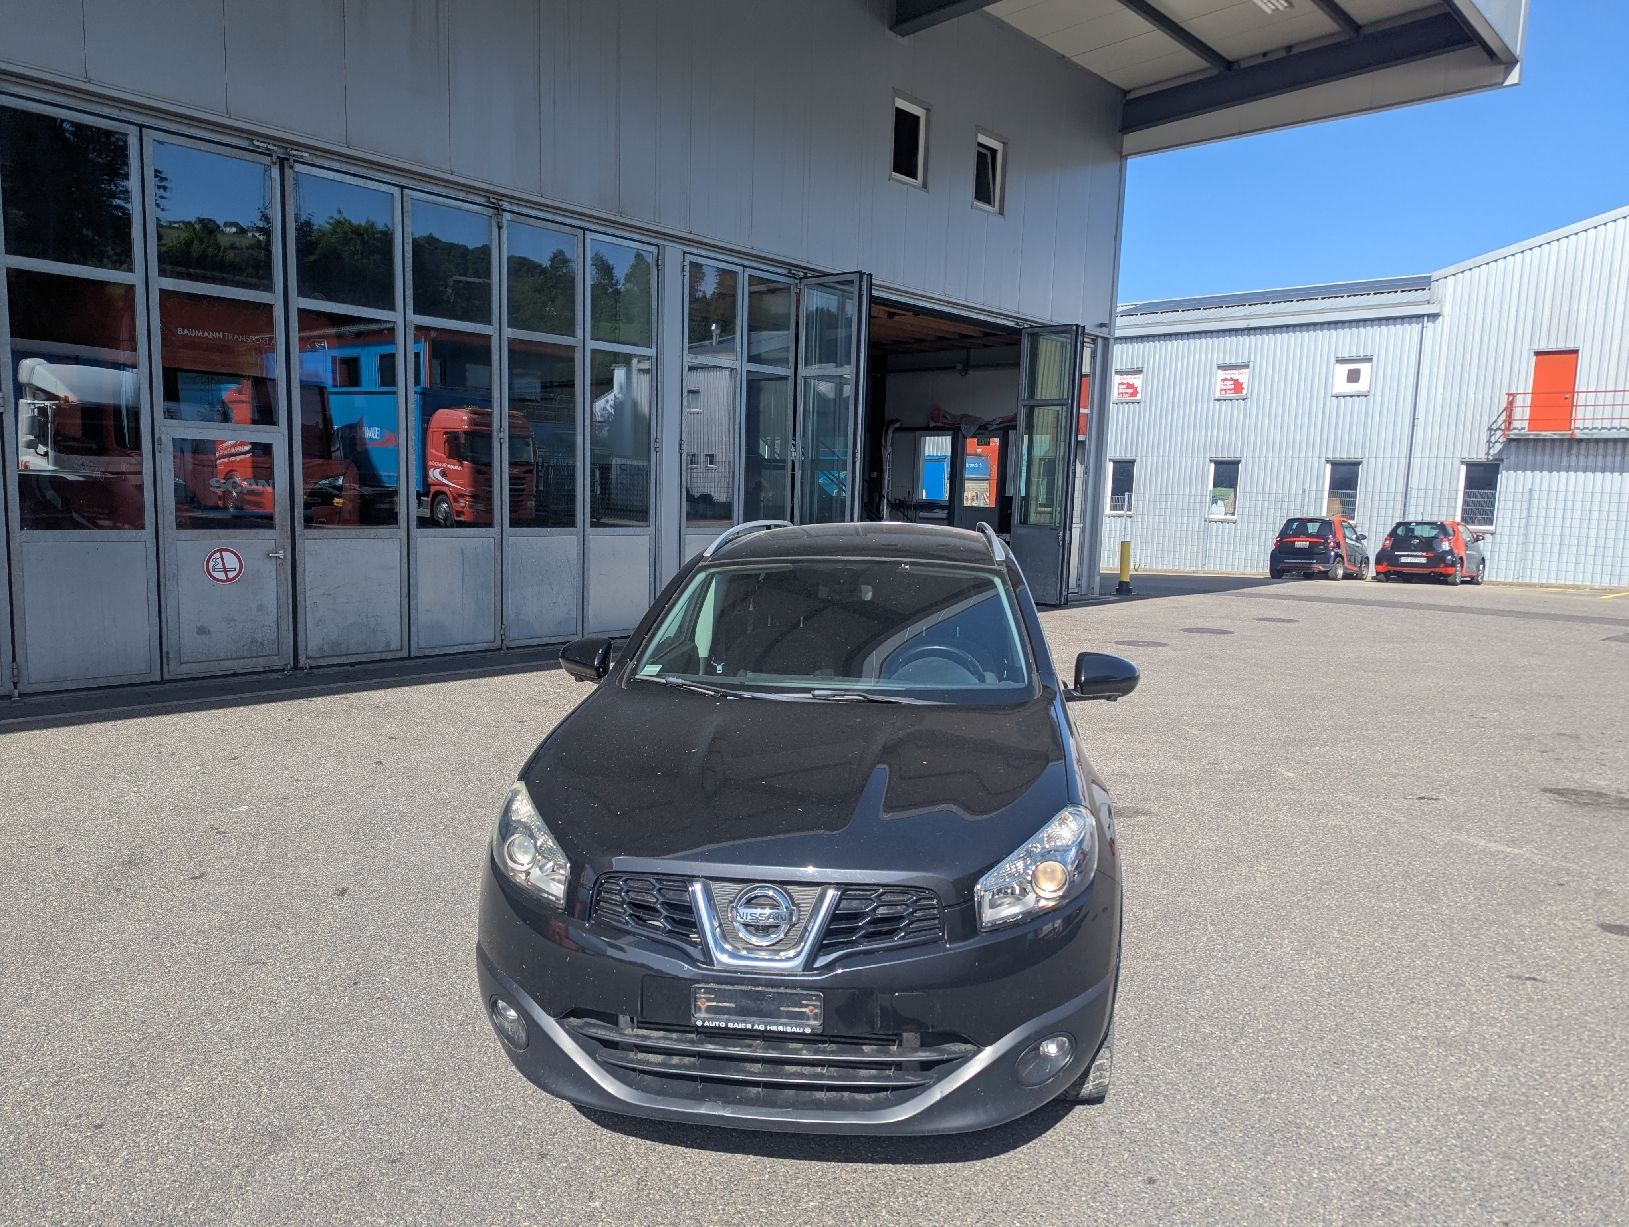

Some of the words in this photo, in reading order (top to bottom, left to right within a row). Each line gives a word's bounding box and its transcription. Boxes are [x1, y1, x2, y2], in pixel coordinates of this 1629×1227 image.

[177, 327, 223, 339] BAUMANN
[736, 911, 787, 921] NISSAN
[703, 1020, 726, 1028] AUTO
[753, 1023, 765, 1031] AG
[766, 1025, 804, 1033] HERISAU
